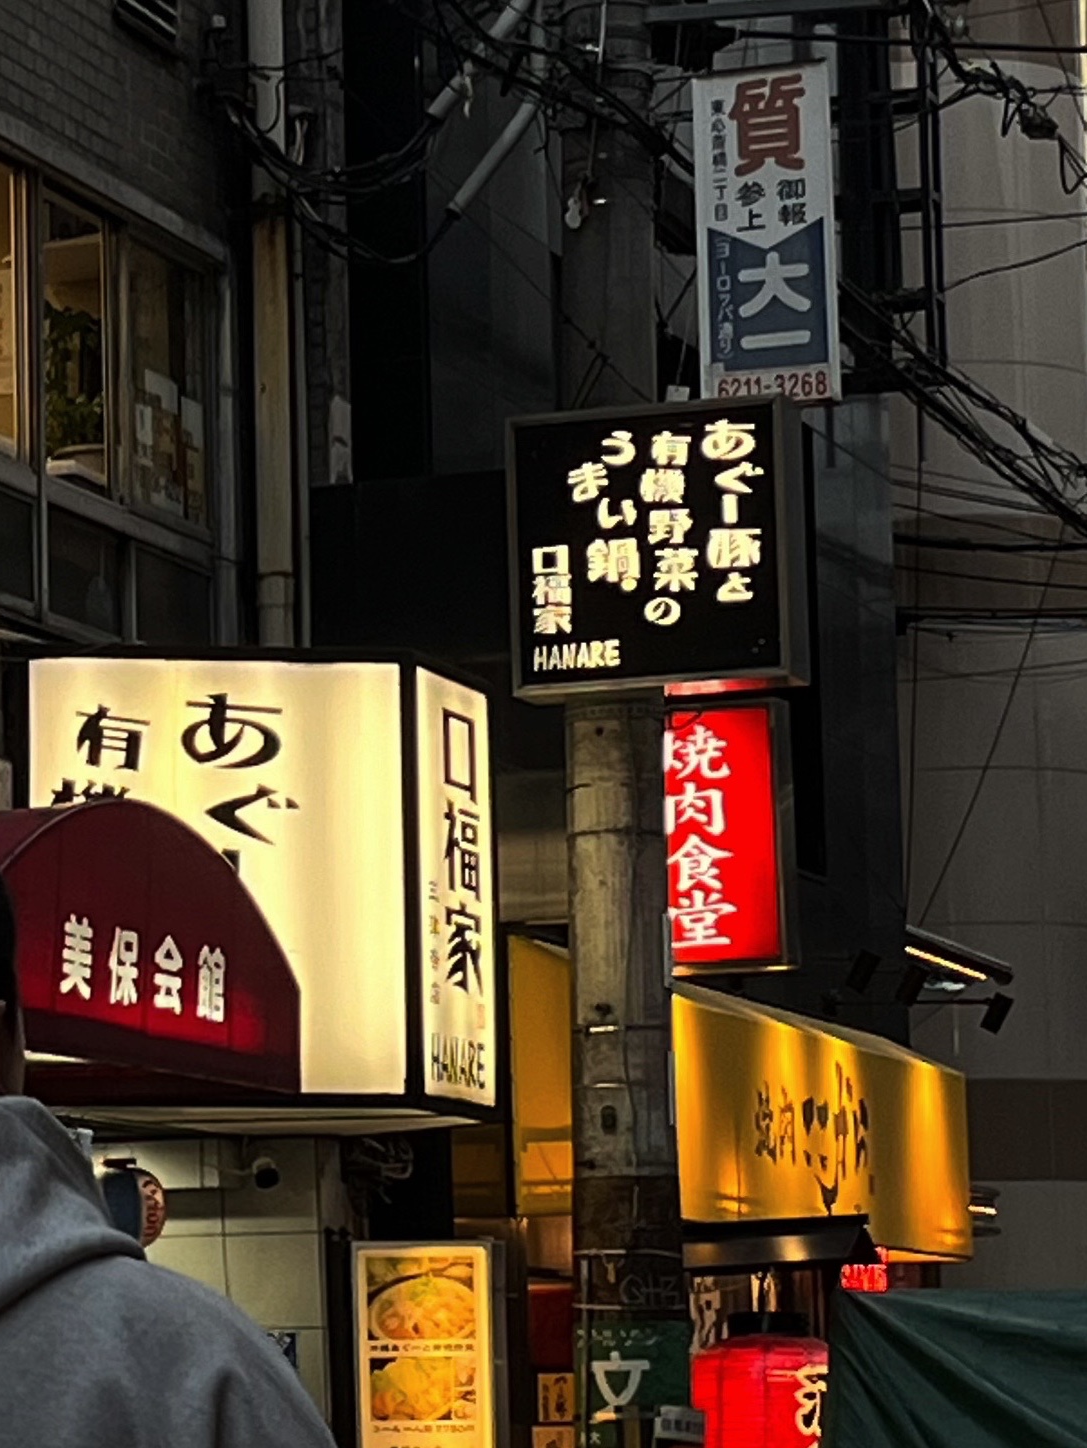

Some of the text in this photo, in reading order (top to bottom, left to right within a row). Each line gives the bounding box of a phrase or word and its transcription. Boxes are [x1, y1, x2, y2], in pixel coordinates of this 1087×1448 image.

[728, 73, 805, 177] 質
[735, 181, 765, 232] 参上
[737, 251, 811, 350] 大一
[717, 371, 828, 398] 6211-3268
[640, 431, 699, 625] 有機野菜の
[701, 419, 764, 602] あぐー豚と
[532, 544, 572, 634] 口福家
[533, 639, 621, 672] HANARE
[51, 704, 150, 807] 有
[442, 708, 483, 997] 口福家
[663, 725, 737, 949] 焼肉食堂
[60, 914, 227, 1023] 美保会館
[431, 1033, 486, 1090] HANARE
